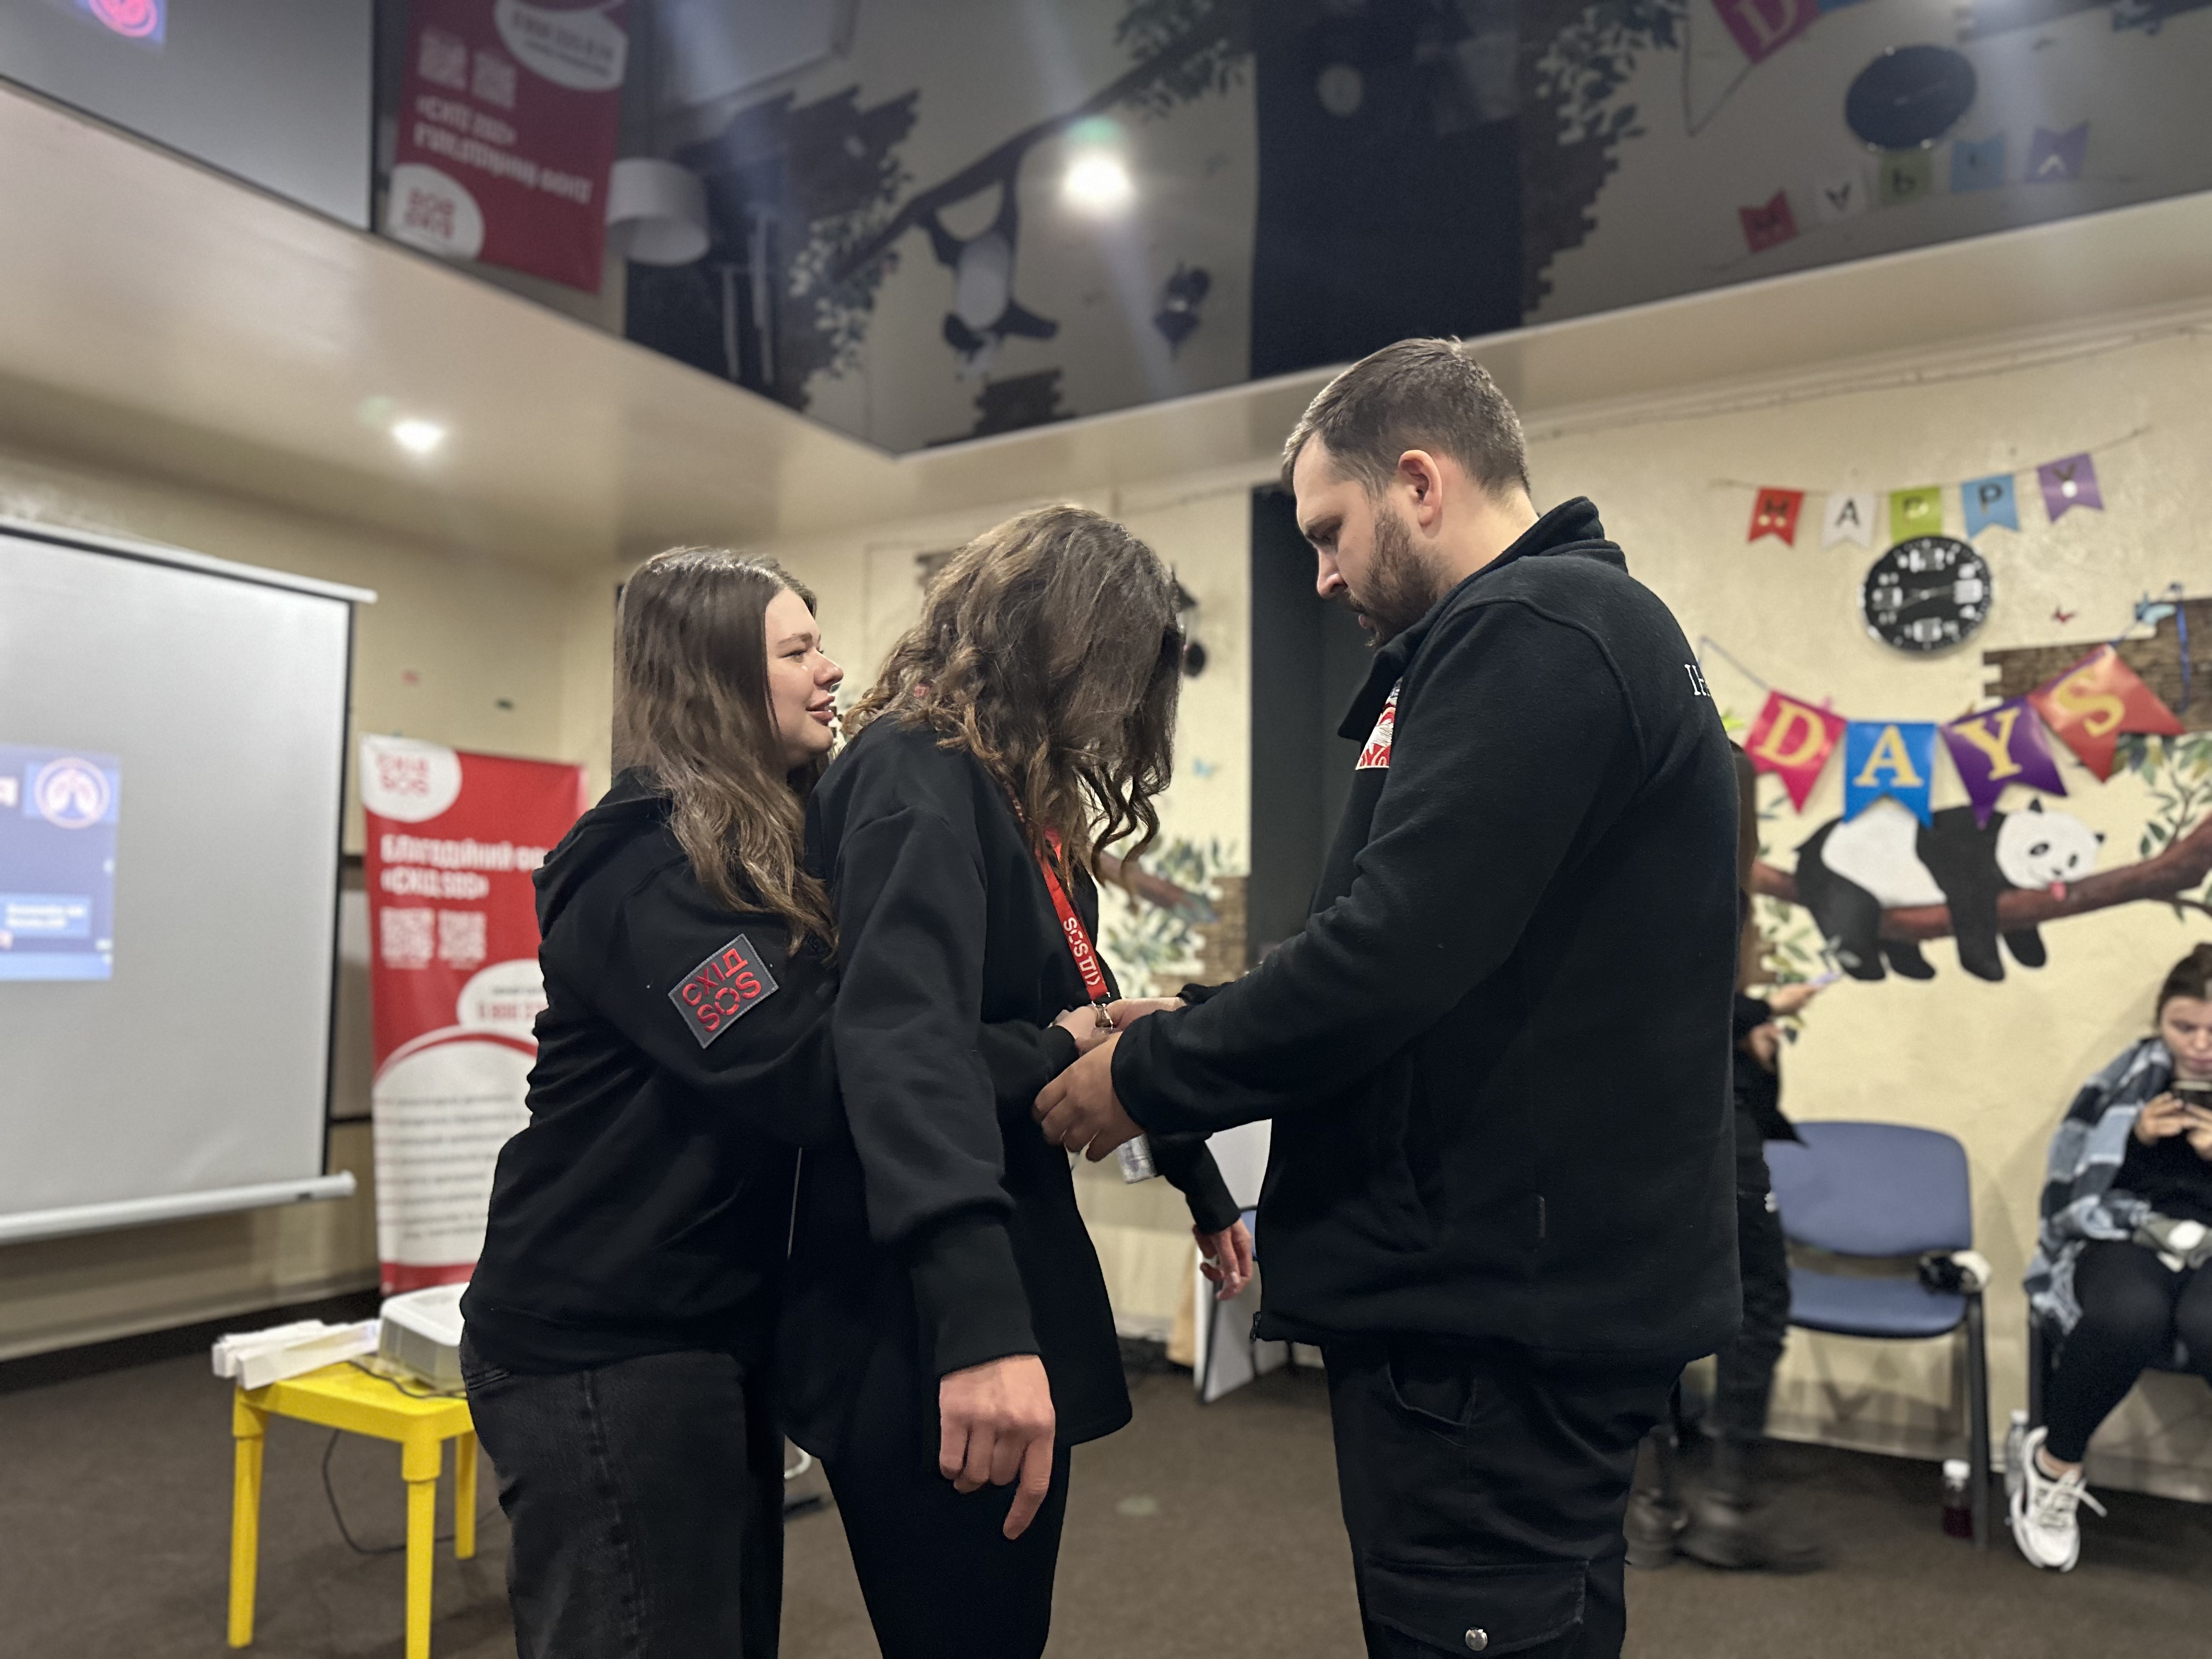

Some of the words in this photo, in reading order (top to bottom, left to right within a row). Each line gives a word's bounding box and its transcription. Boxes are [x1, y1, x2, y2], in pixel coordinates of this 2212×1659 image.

[1757, 668, 2126, 789] DAYS
[1063, 917, 1088, 957] SOS
[682, 948, 748, 1006] СХІД
[697, 972, 761, 1032] SOS
